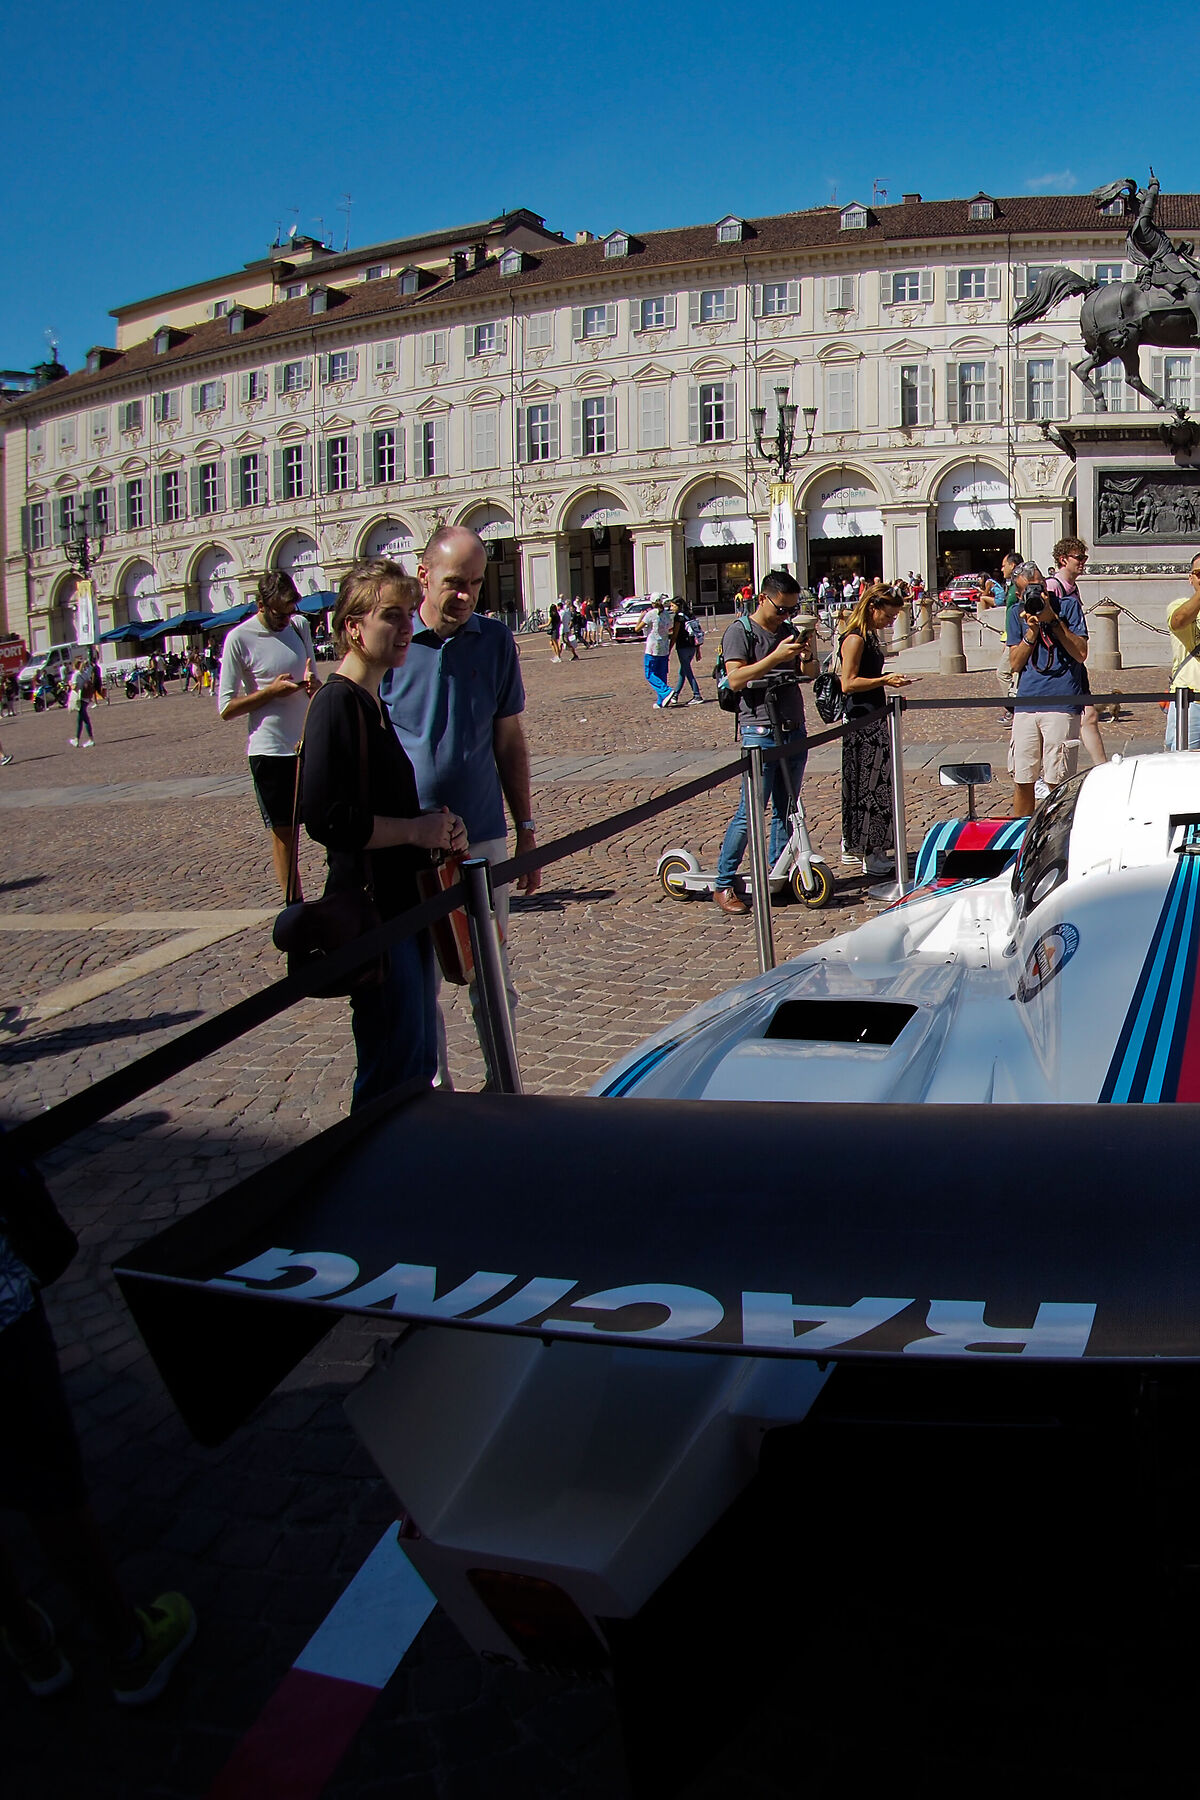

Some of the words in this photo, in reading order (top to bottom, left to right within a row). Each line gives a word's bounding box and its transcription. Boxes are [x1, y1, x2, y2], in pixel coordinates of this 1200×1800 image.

[821, 490, 848, 500] BANCO
[850, 489, 866, 498] BPM
[697, 500, 723, 510] BANCO
[725, 499, 740, 507] BPM
[580, 511, 606, 522] BANCO
[607, 510, 621, 519] BPM
[210, 1247, 1097, 1359] RACING
